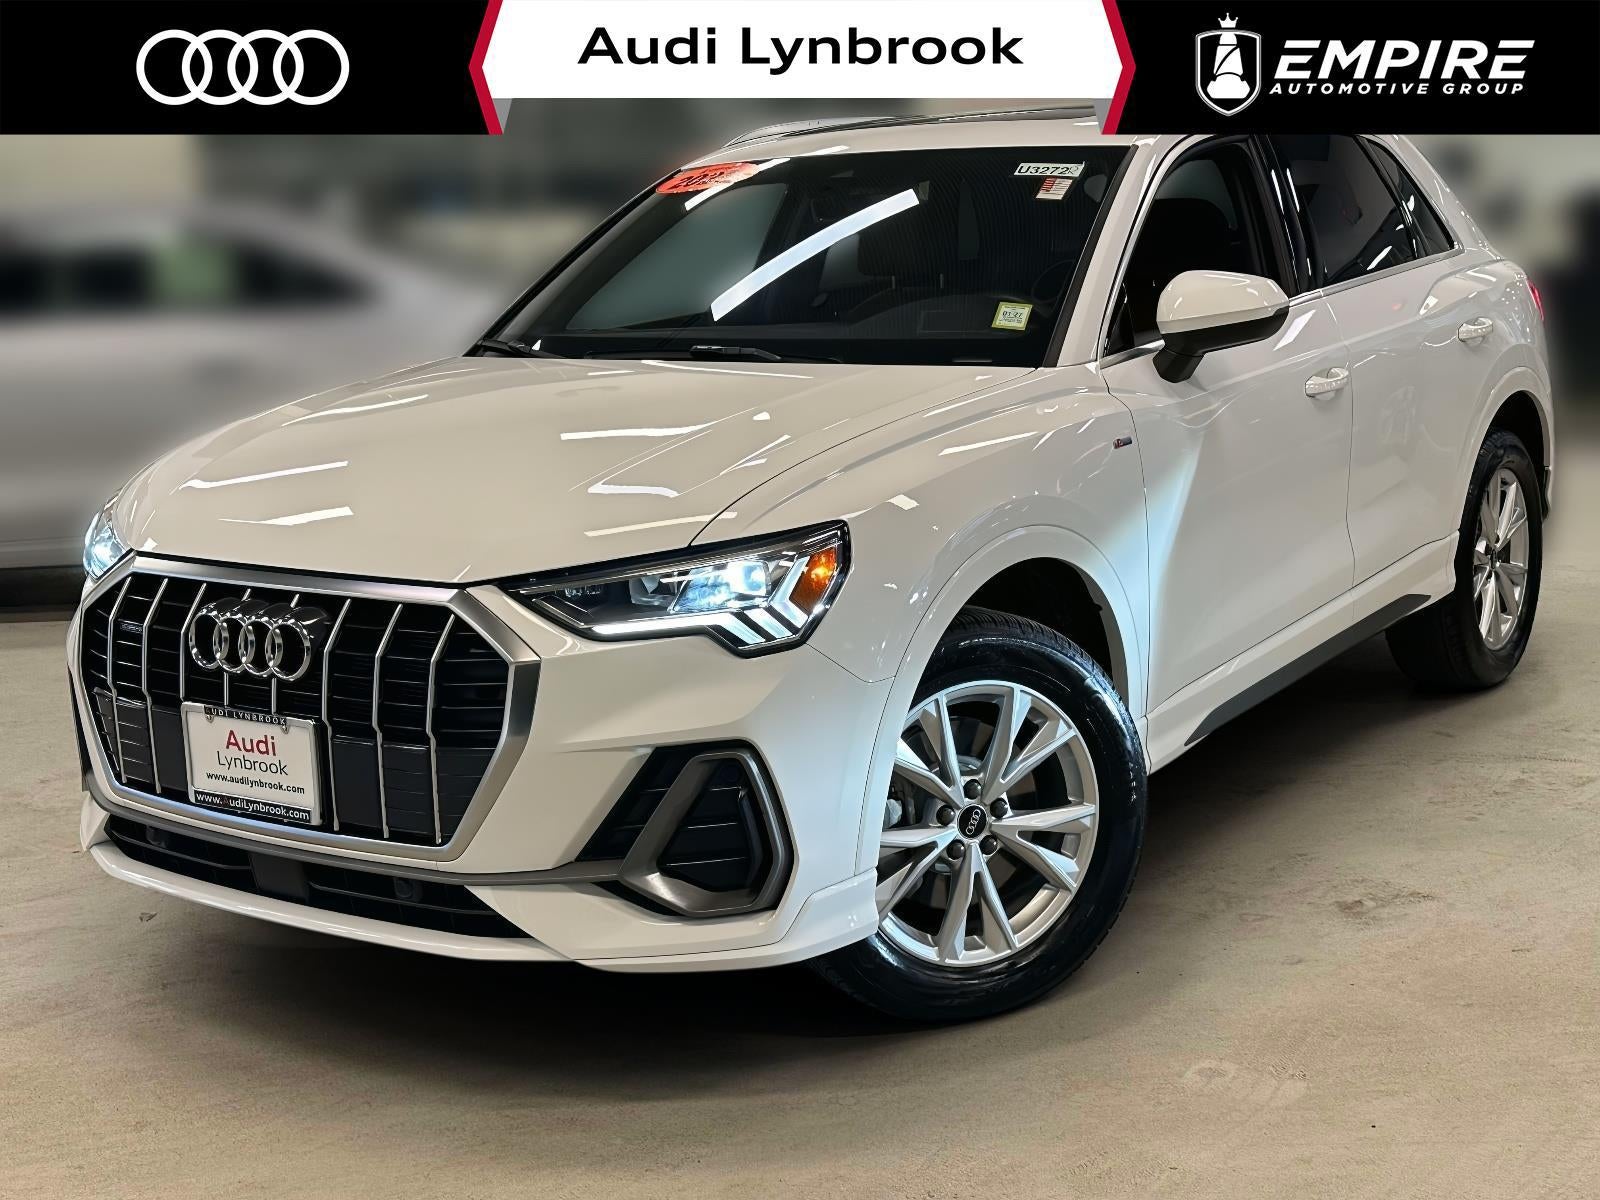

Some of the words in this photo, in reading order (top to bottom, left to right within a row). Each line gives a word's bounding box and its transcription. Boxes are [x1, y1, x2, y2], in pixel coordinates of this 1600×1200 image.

[233, 711, 287, 725] LYNBROOK
[225, 729, 277, 757] Audi
[216, 750, 289, 776] Lynbrook
[205, 771, 305, 795] www.audilynbrook.com
